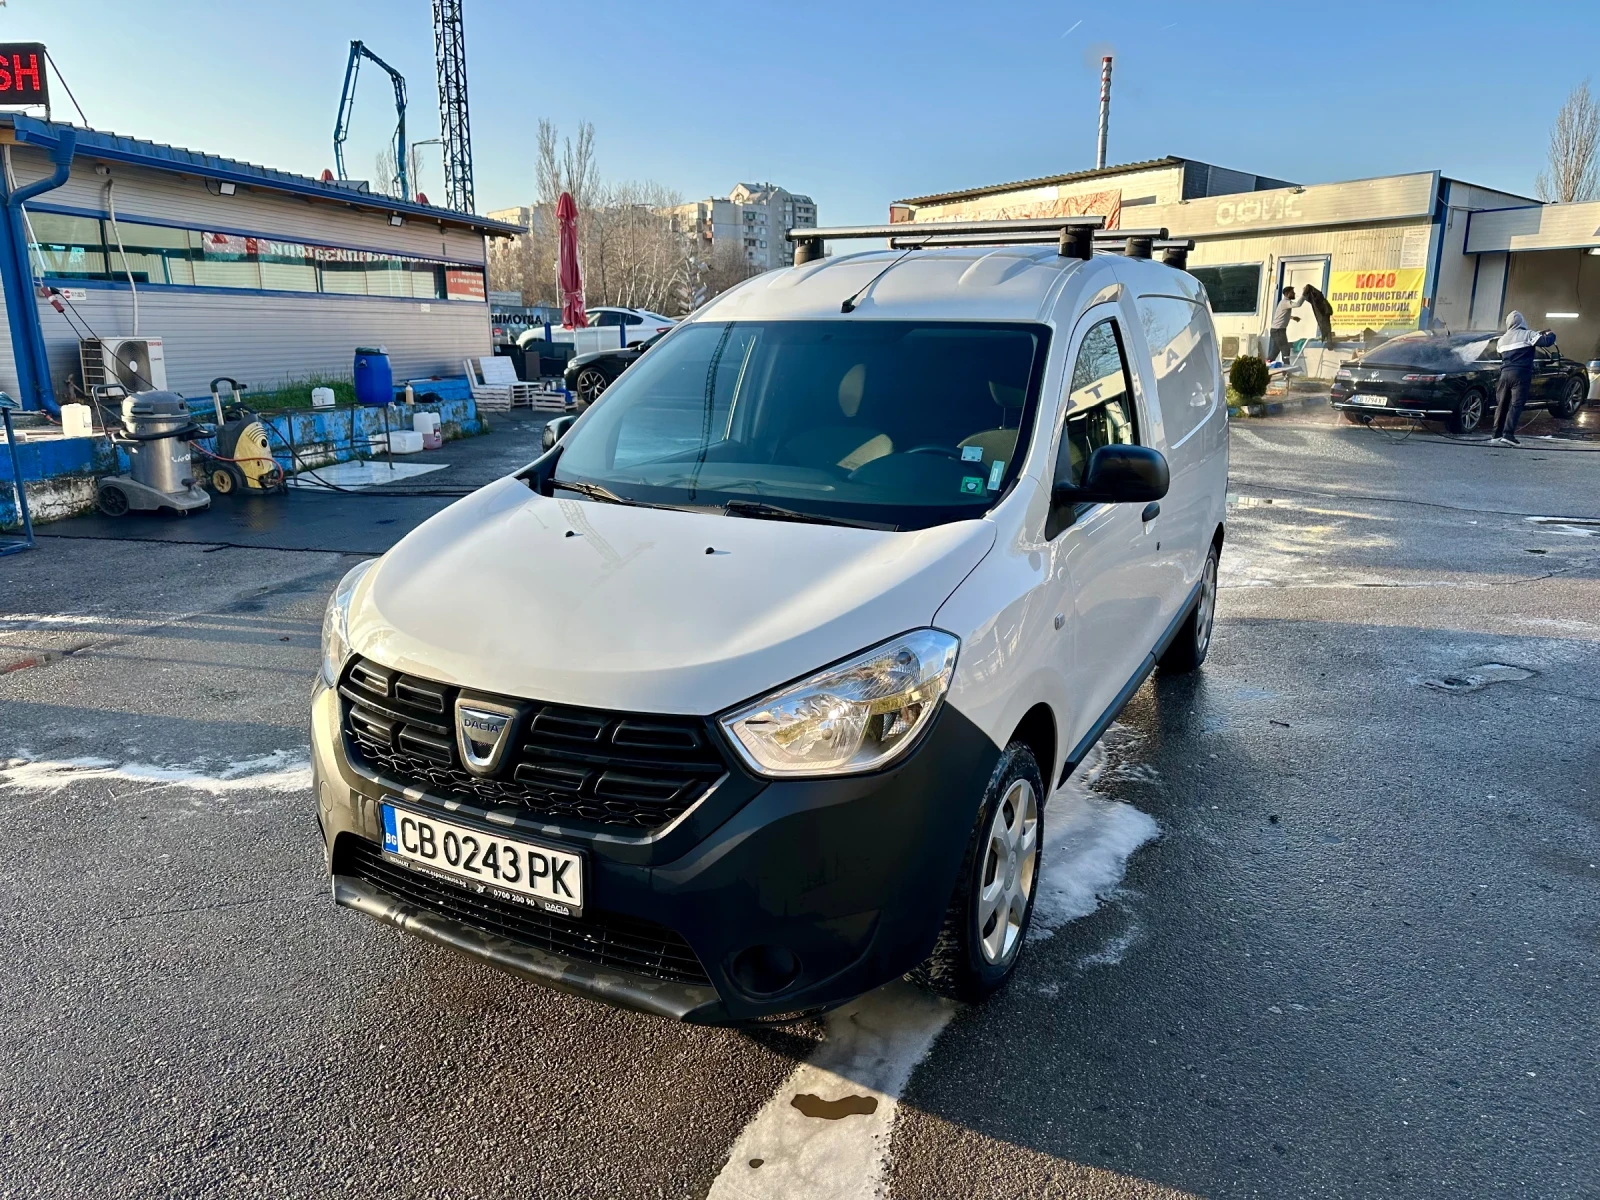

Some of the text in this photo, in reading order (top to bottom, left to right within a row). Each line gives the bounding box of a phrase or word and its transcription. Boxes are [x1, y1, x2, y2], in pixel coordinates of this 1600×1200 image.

[1332, 290, 1418, 301] ПАРНО ПОЧИСТВАНЕ
[1337, 302, 1410, 312] НА АВТОМОБИЛИ
[464, 718, 499, 733] DACIA
[385, 817, 575, 899] BG CB 0243 PK
[493, 889, 510, 900] 0700
[511, 893, 525, 904] 200
[544, 902, 570, 915] DACIA
